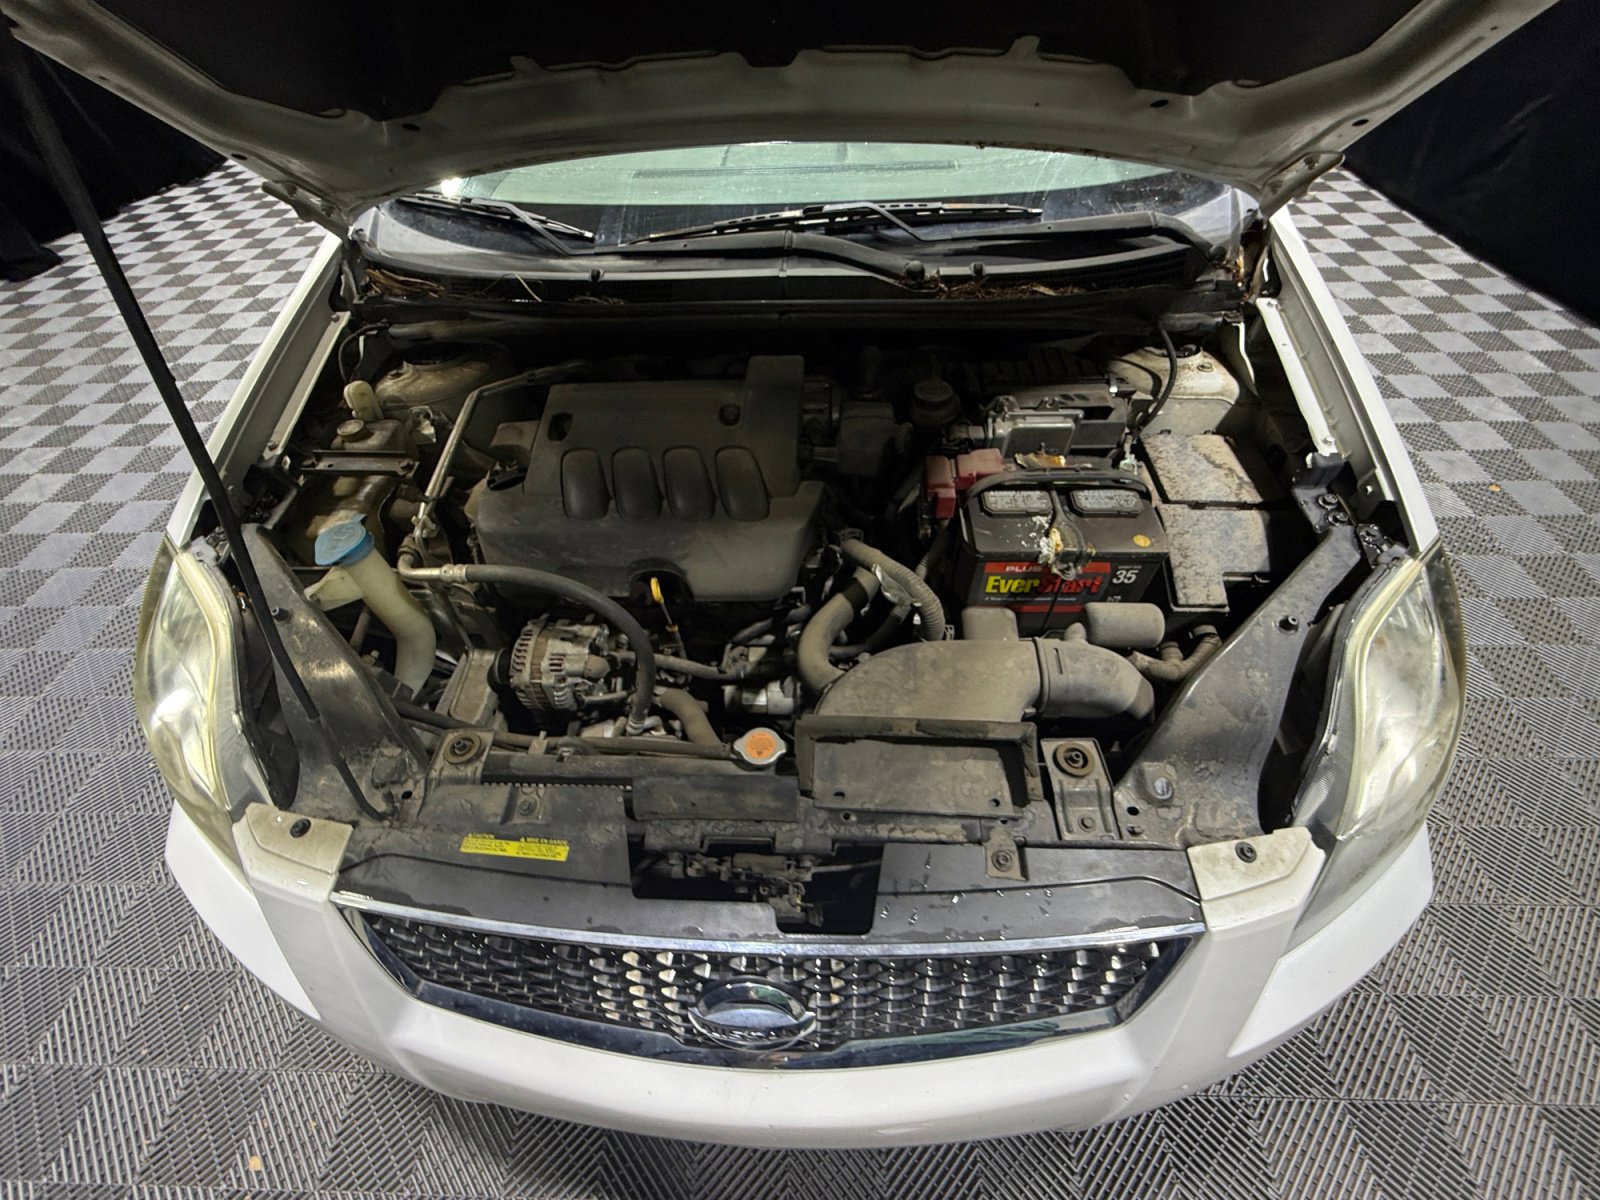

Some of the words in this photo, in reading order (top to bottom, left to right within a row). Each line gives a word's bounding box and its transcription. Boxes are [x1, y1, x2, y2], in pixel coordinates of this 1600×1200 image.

[1005, 565, 1042, 573] PLUS
[1112, 569, 1139, 584] 35
[985, 575, 1104, 593] EverStart
